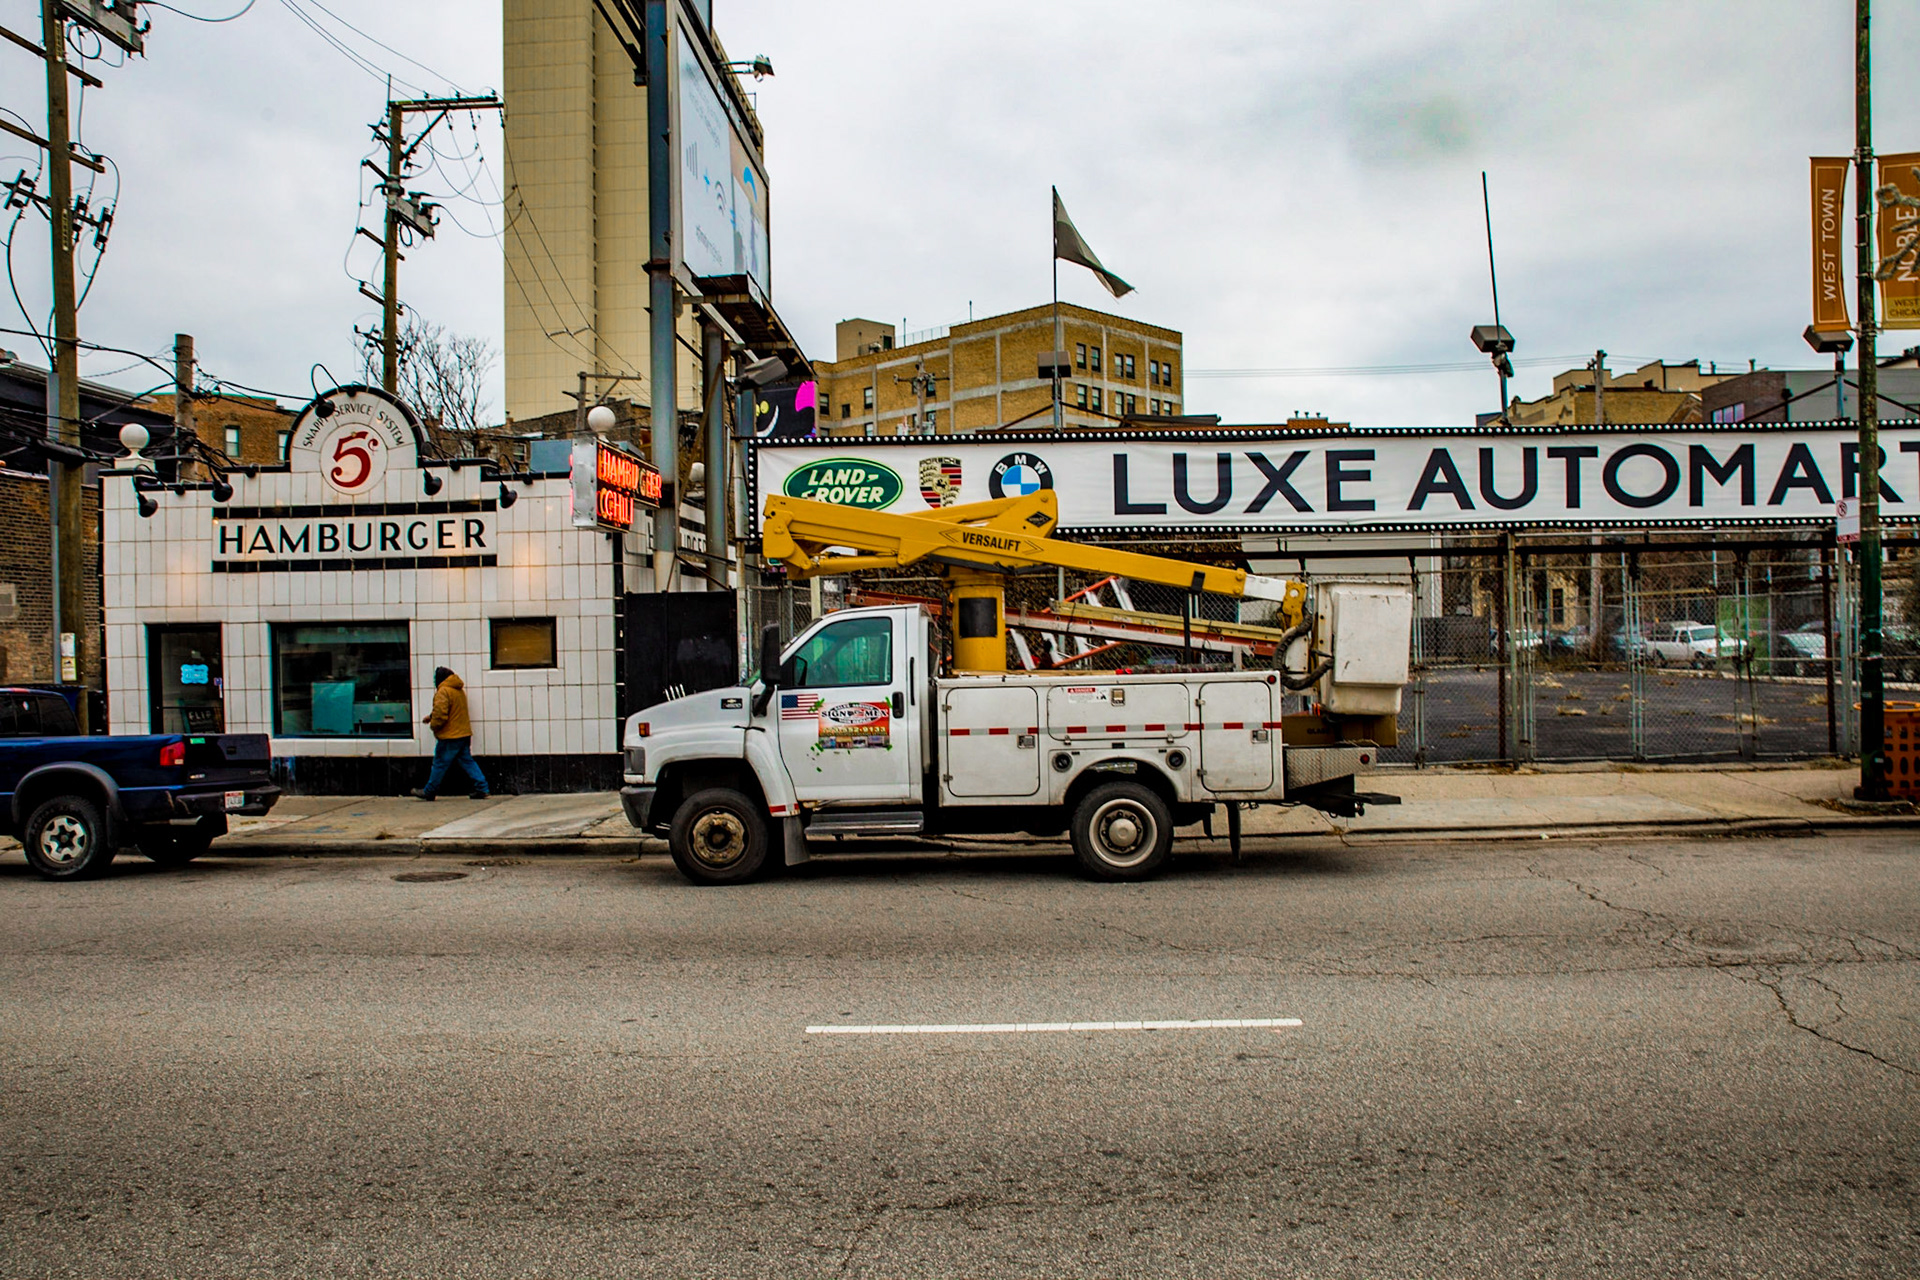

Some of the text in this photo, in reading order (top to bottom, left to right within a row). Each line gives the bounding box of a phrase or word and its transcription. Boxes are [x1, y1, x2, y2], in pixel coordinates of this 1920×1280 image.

[1822, 188, 1837, 301] WEST TOWN
[303, 403, 404, 447] SNAPP SERVICE SYSTEM
[597, 449, 662, 499] HAMBUGER
[919, 457, 961, 467] PORSCHE
[995, 454, 1048, 475] BMW
[808, 469, 866, 486] LAND
[1113, 449, 1376, 515] LUXE
[815, 487, 884, 504] ROVER
[219, 518, 486, 554] HAMBURGER
[962, 531, 1021, 552] VERSALIFT
